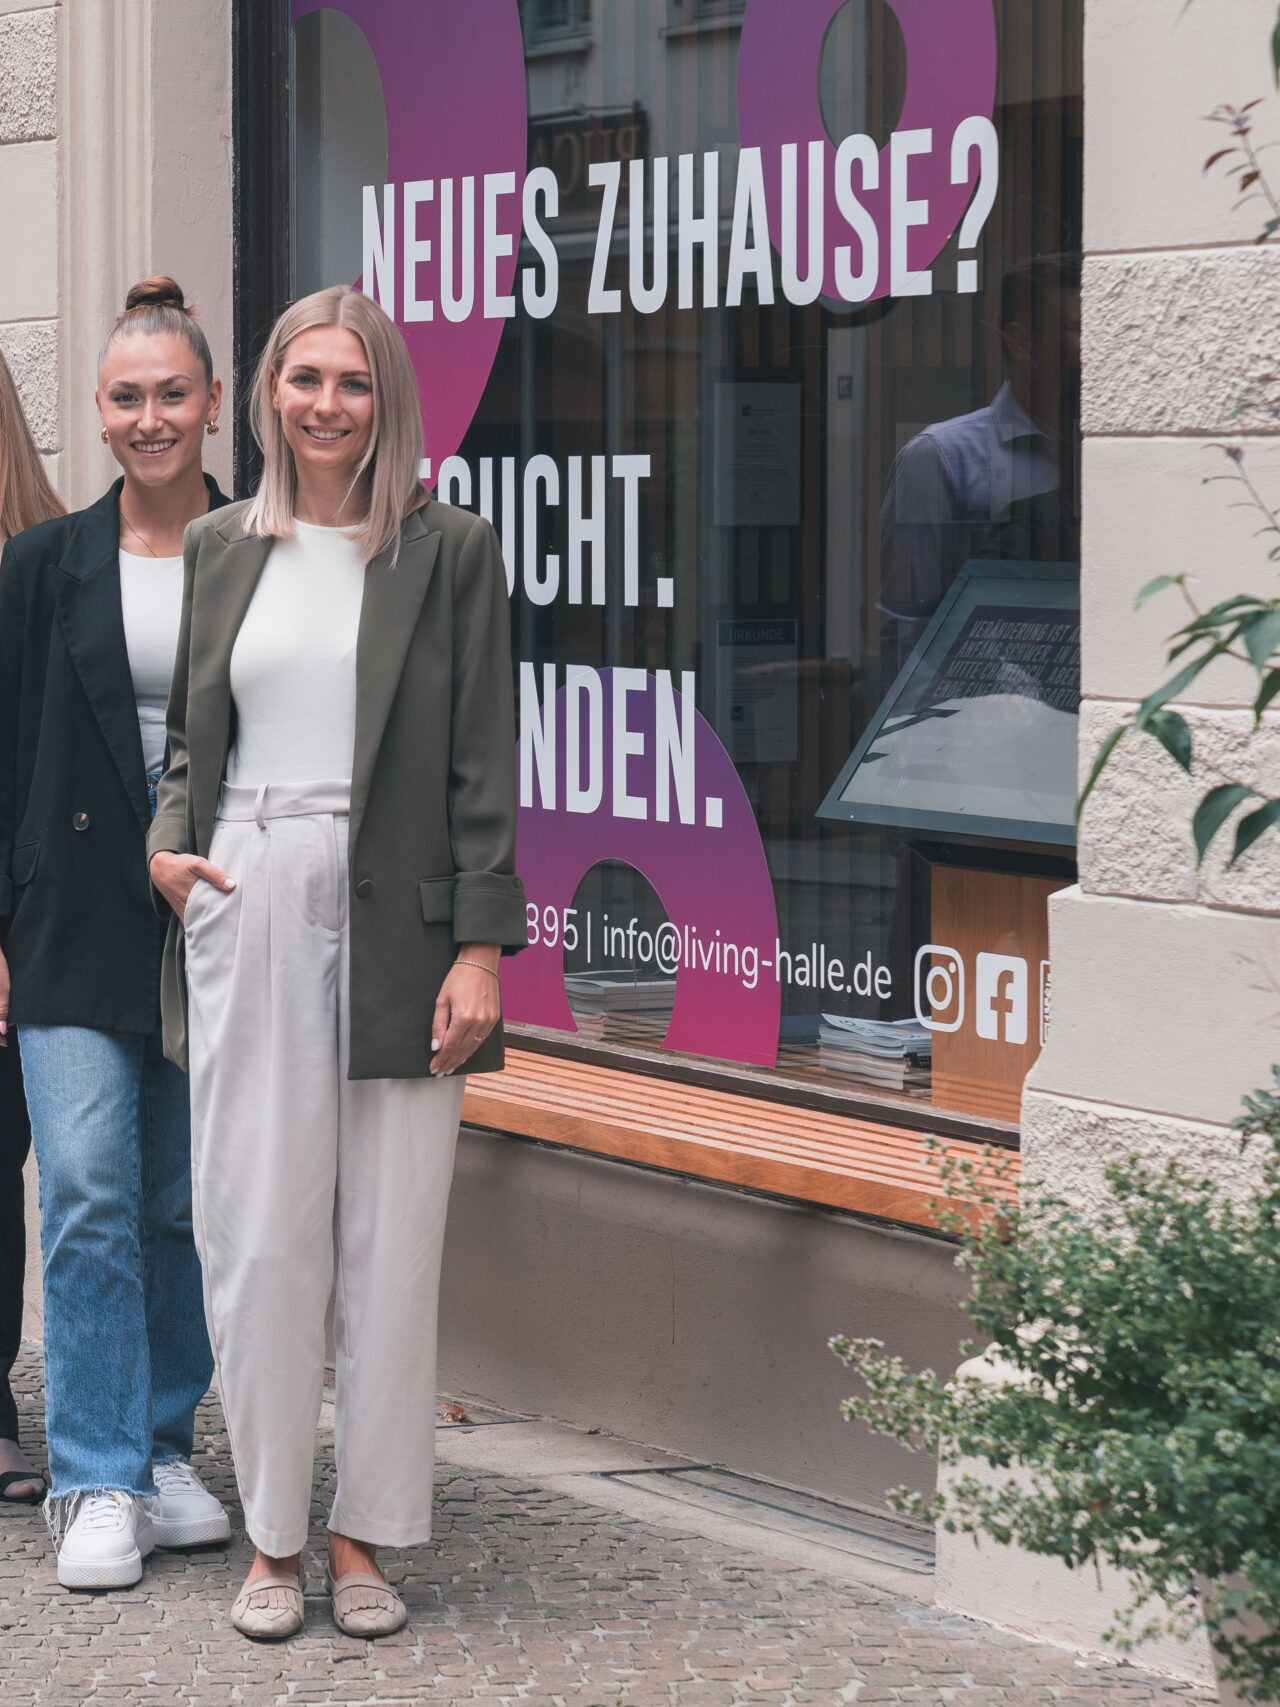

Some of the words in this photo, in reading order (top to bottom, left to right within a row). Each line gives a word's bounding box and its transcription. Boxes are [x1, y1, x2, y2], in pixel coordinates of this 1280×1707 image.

[362, 166, 559, 322] NEUES
[587, 115, 999, 314] ZUHAUSE?
[419, 454, 674, 607] UCHT.
[729, 627, 784, 642] URKUNDE
[969, 619, 1050, 642] VERÄNDERUNG
[1046, 624, 1071, 642] IST
[956, 640, 1003, 659] ANFANG
[1053, 646, 1073, 664] IN
[944, 660, 983, 679] MITTE
[1047, 666, 1080, 686] ABER
[933, 680, 965, 698] ENDE
[520, 661, 723, 828] NDEN.
[526, 903, 578, 950] 895
[603, 914, 892, 999] info@living-halle.de
